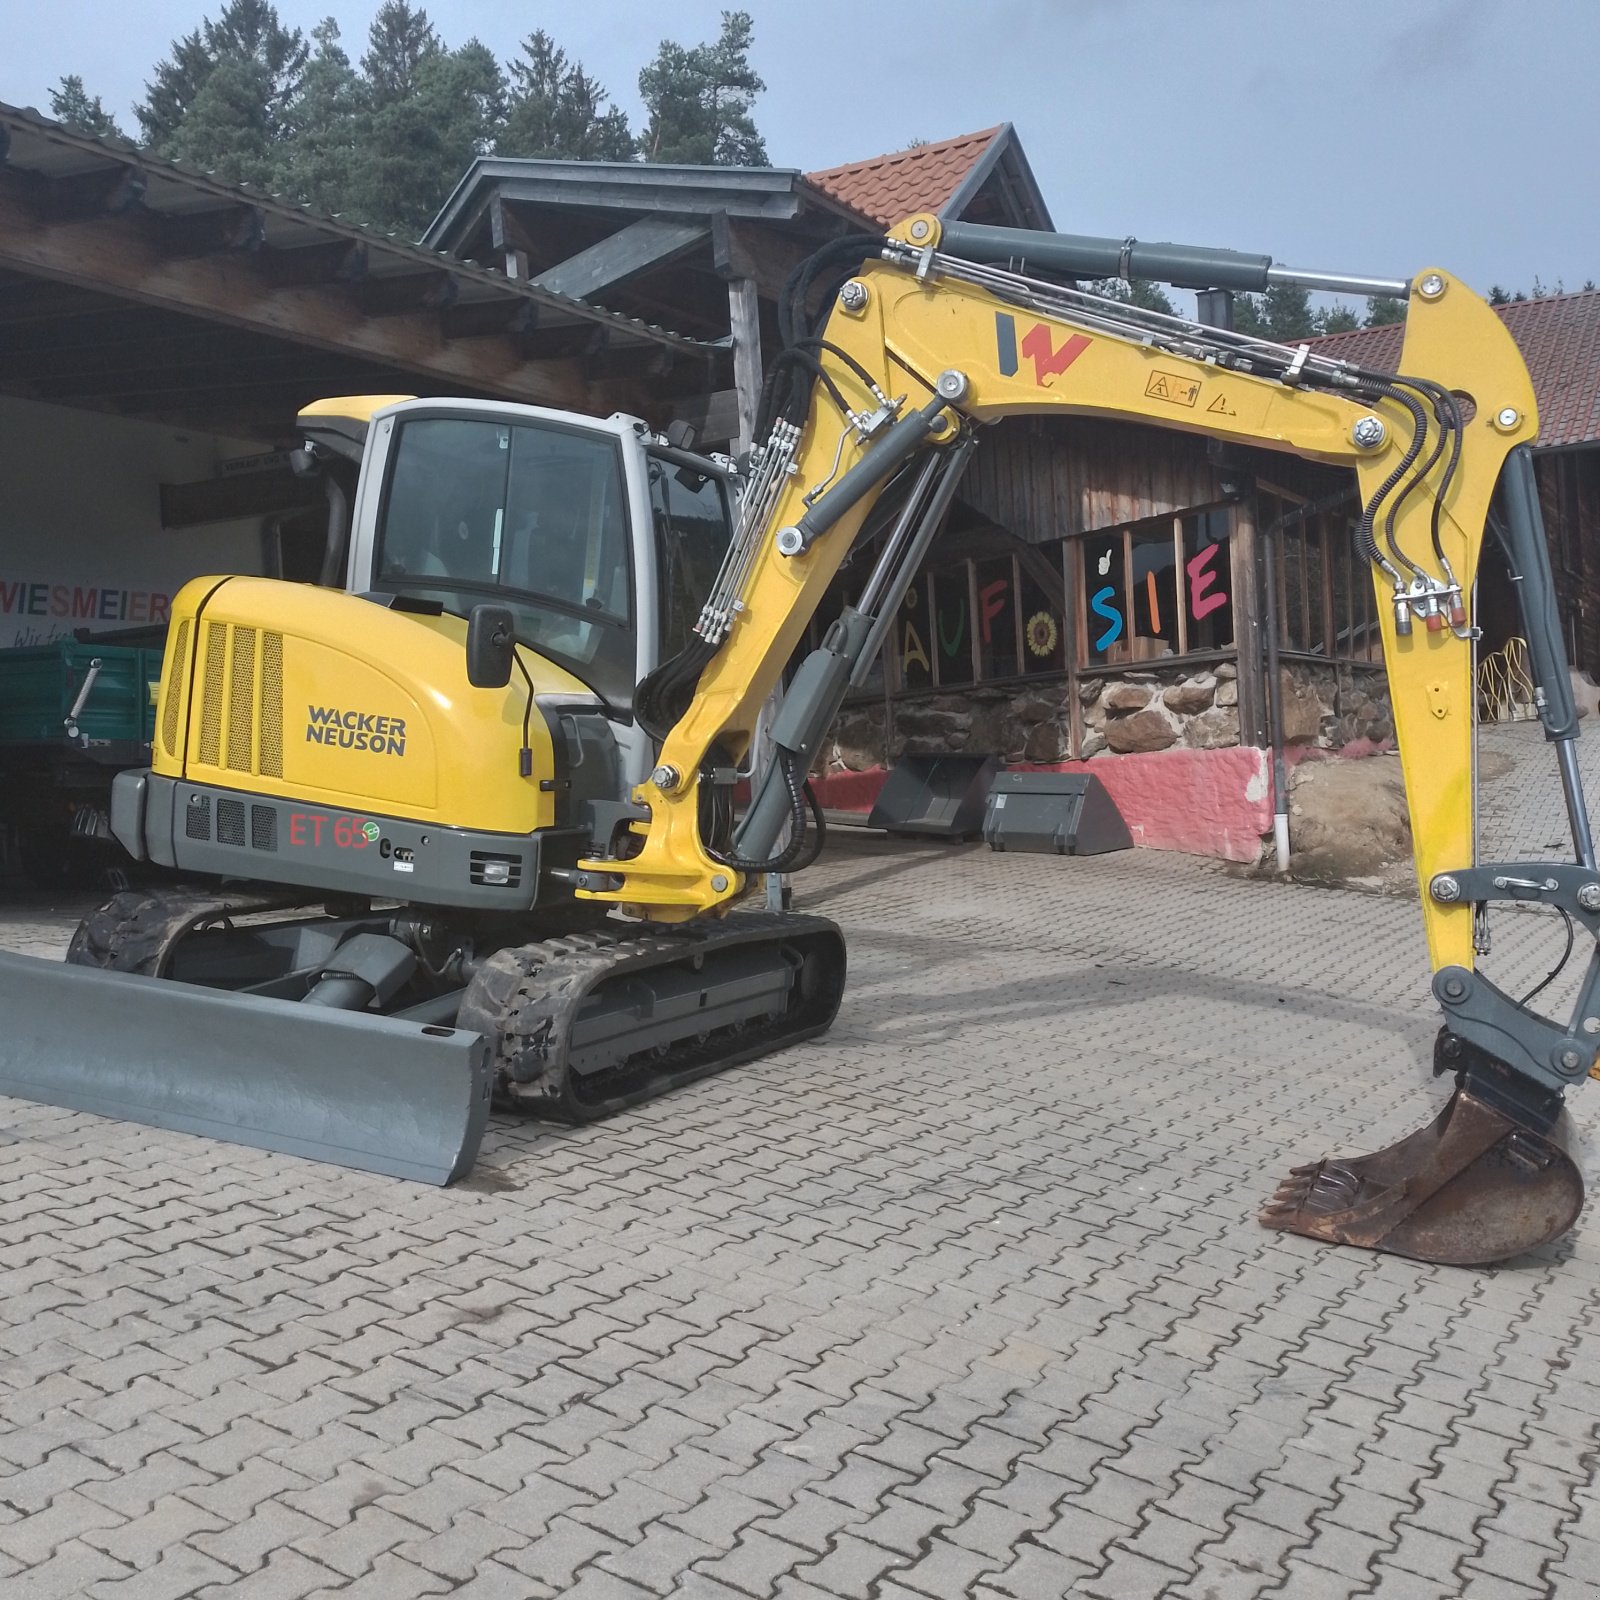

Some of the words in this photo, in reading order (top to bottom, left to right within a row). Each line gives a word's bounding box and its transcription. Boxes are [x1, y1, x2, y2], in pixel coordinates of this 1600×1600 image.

[902, 578, 1008, 673] AUF
[1091, 543, 1228, 652] SIE
[307, 705, 406, 738] WACKER
[306, 724, 406, 757] NEUSON
[289, 814, 329, 847] ET
[333, 816, 370, 849] 65
